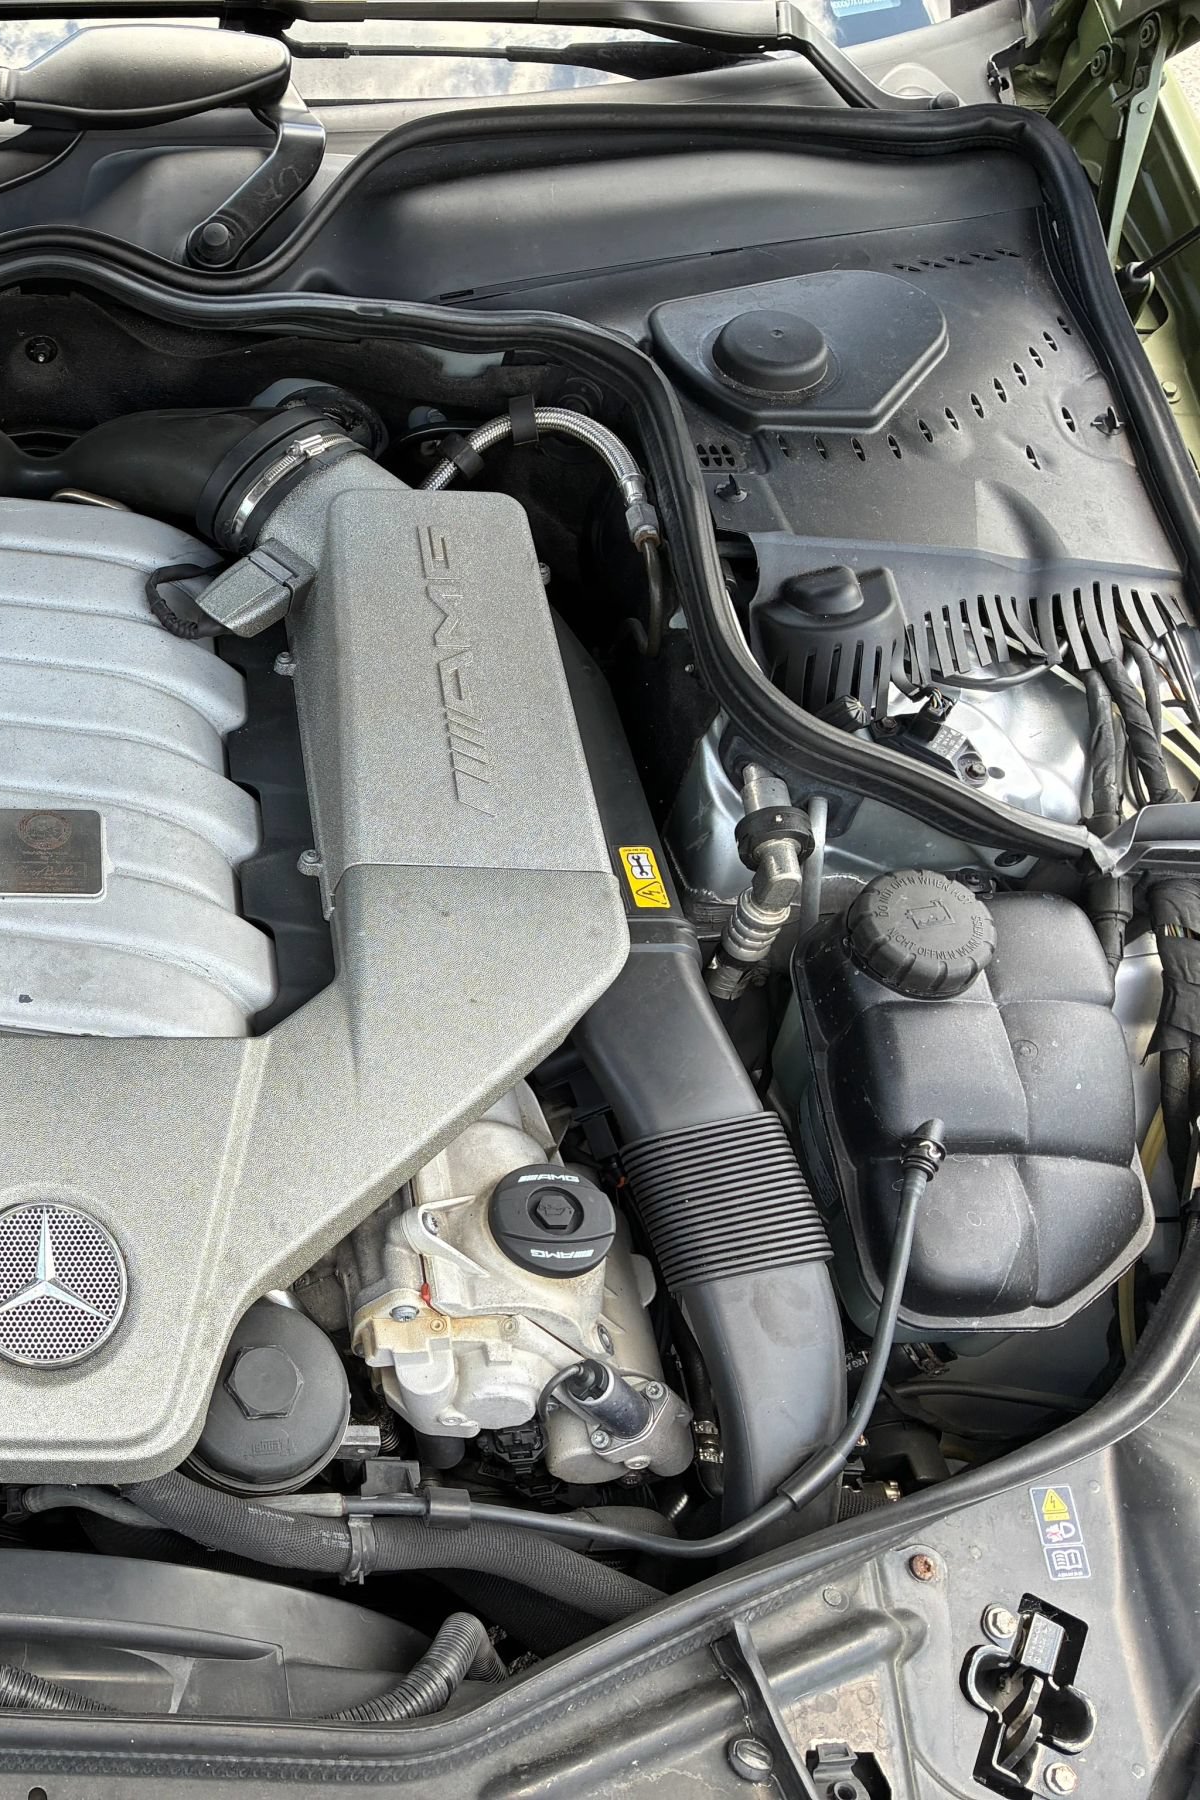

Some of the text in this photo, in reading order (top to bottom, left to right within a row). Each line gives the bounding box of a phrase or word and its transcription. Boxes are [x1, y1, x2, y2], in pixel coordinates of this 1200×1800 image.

[417, 525, 483, 722] AMG
[878, 903, 890, 919] DO
[891, 876, 916, 892] OPEN
[918, 876, 950, 892] WHEN
[887, 926, 917, 951] NICHT
